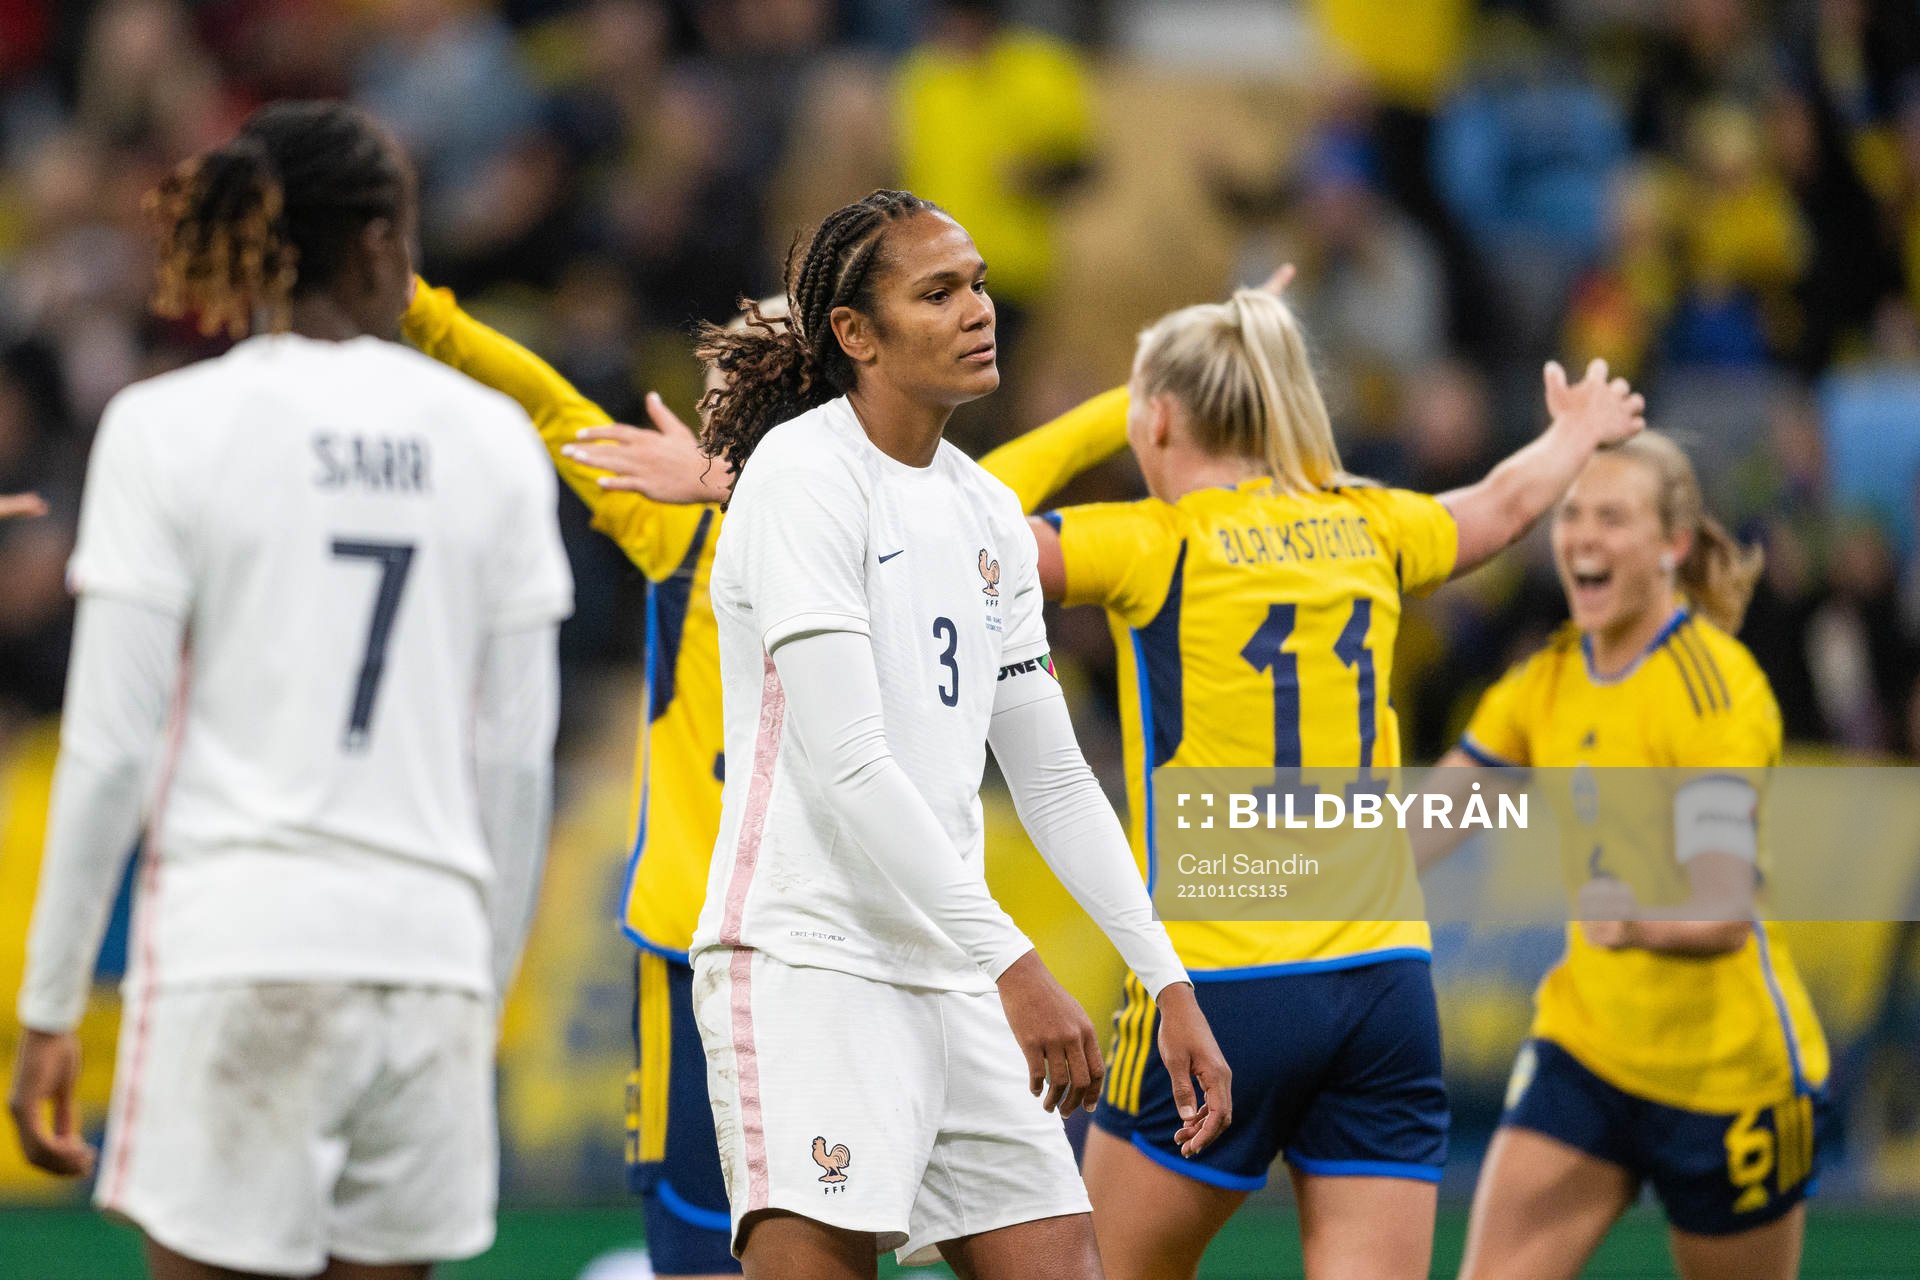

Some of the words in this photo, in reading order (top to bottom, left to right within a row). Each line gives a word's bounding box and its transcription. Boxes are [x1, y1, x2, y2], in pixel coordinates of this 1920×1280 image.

[330, 539, 416, 750] 7
[932, 616, 959, 708] 3
[1240, 598, 1389, 816] 11
[1725, 1107, 1774, 1187] 6
